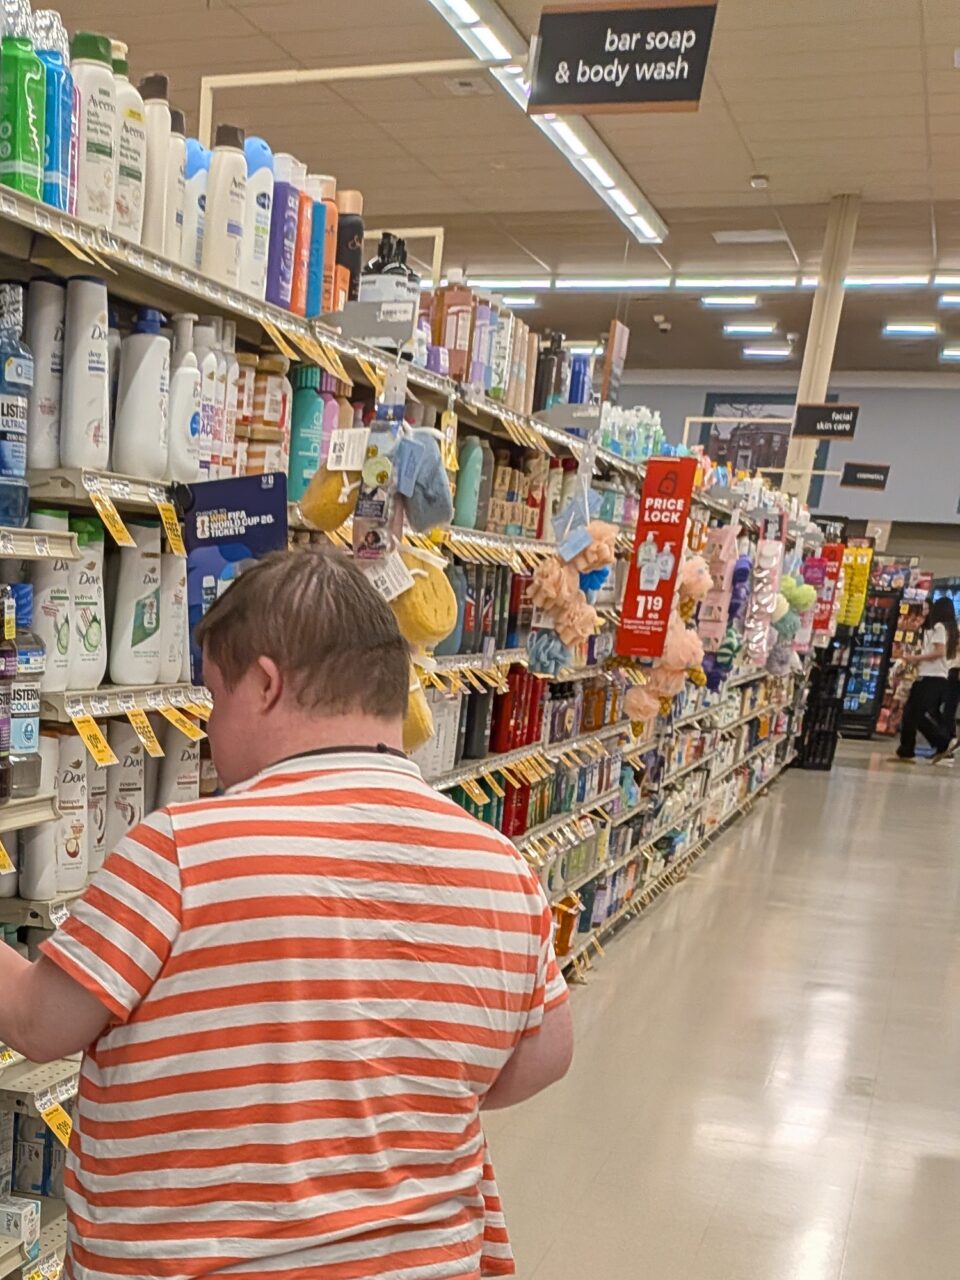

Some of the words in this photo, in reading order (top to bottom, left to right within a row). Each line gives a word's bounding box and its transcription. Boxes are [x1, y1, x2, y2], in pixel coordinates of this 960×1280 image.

[605, 28, 640, 52] bar
[646, 29, 696, 53] soap
[555, 61, 570, 84] &
[576, 58, 629, 87] body
[635, 54, 688, 81] wash
[88, 94, 116, 113] Aveeno
[121, 120, 145, 140] Aveeno
[832, 411, 852, 421] facial
[816, 421, 832, 430] skin
[834, 423, 850, 431] care
[856, 472, 884, 480] cosmetics
[645, 498, 684, 511] PRICE
[210, 513, 227, 522] WIN
[228, 510, 246, 519] FIFA
[644, 511, 680, 523] LOCK
[210, 520, 241, 530] WORLD
[242, 516, 259, 526] CUP
[210, 526, 245, 537] TICKETS
[79, 571, 101, 585] Dove
[143, 573, 159, 585] Dove
[123, 756, 144, 767] Dove
[180, 750, 199, 762] Dove
[62, 772, 86, 784] Dove
